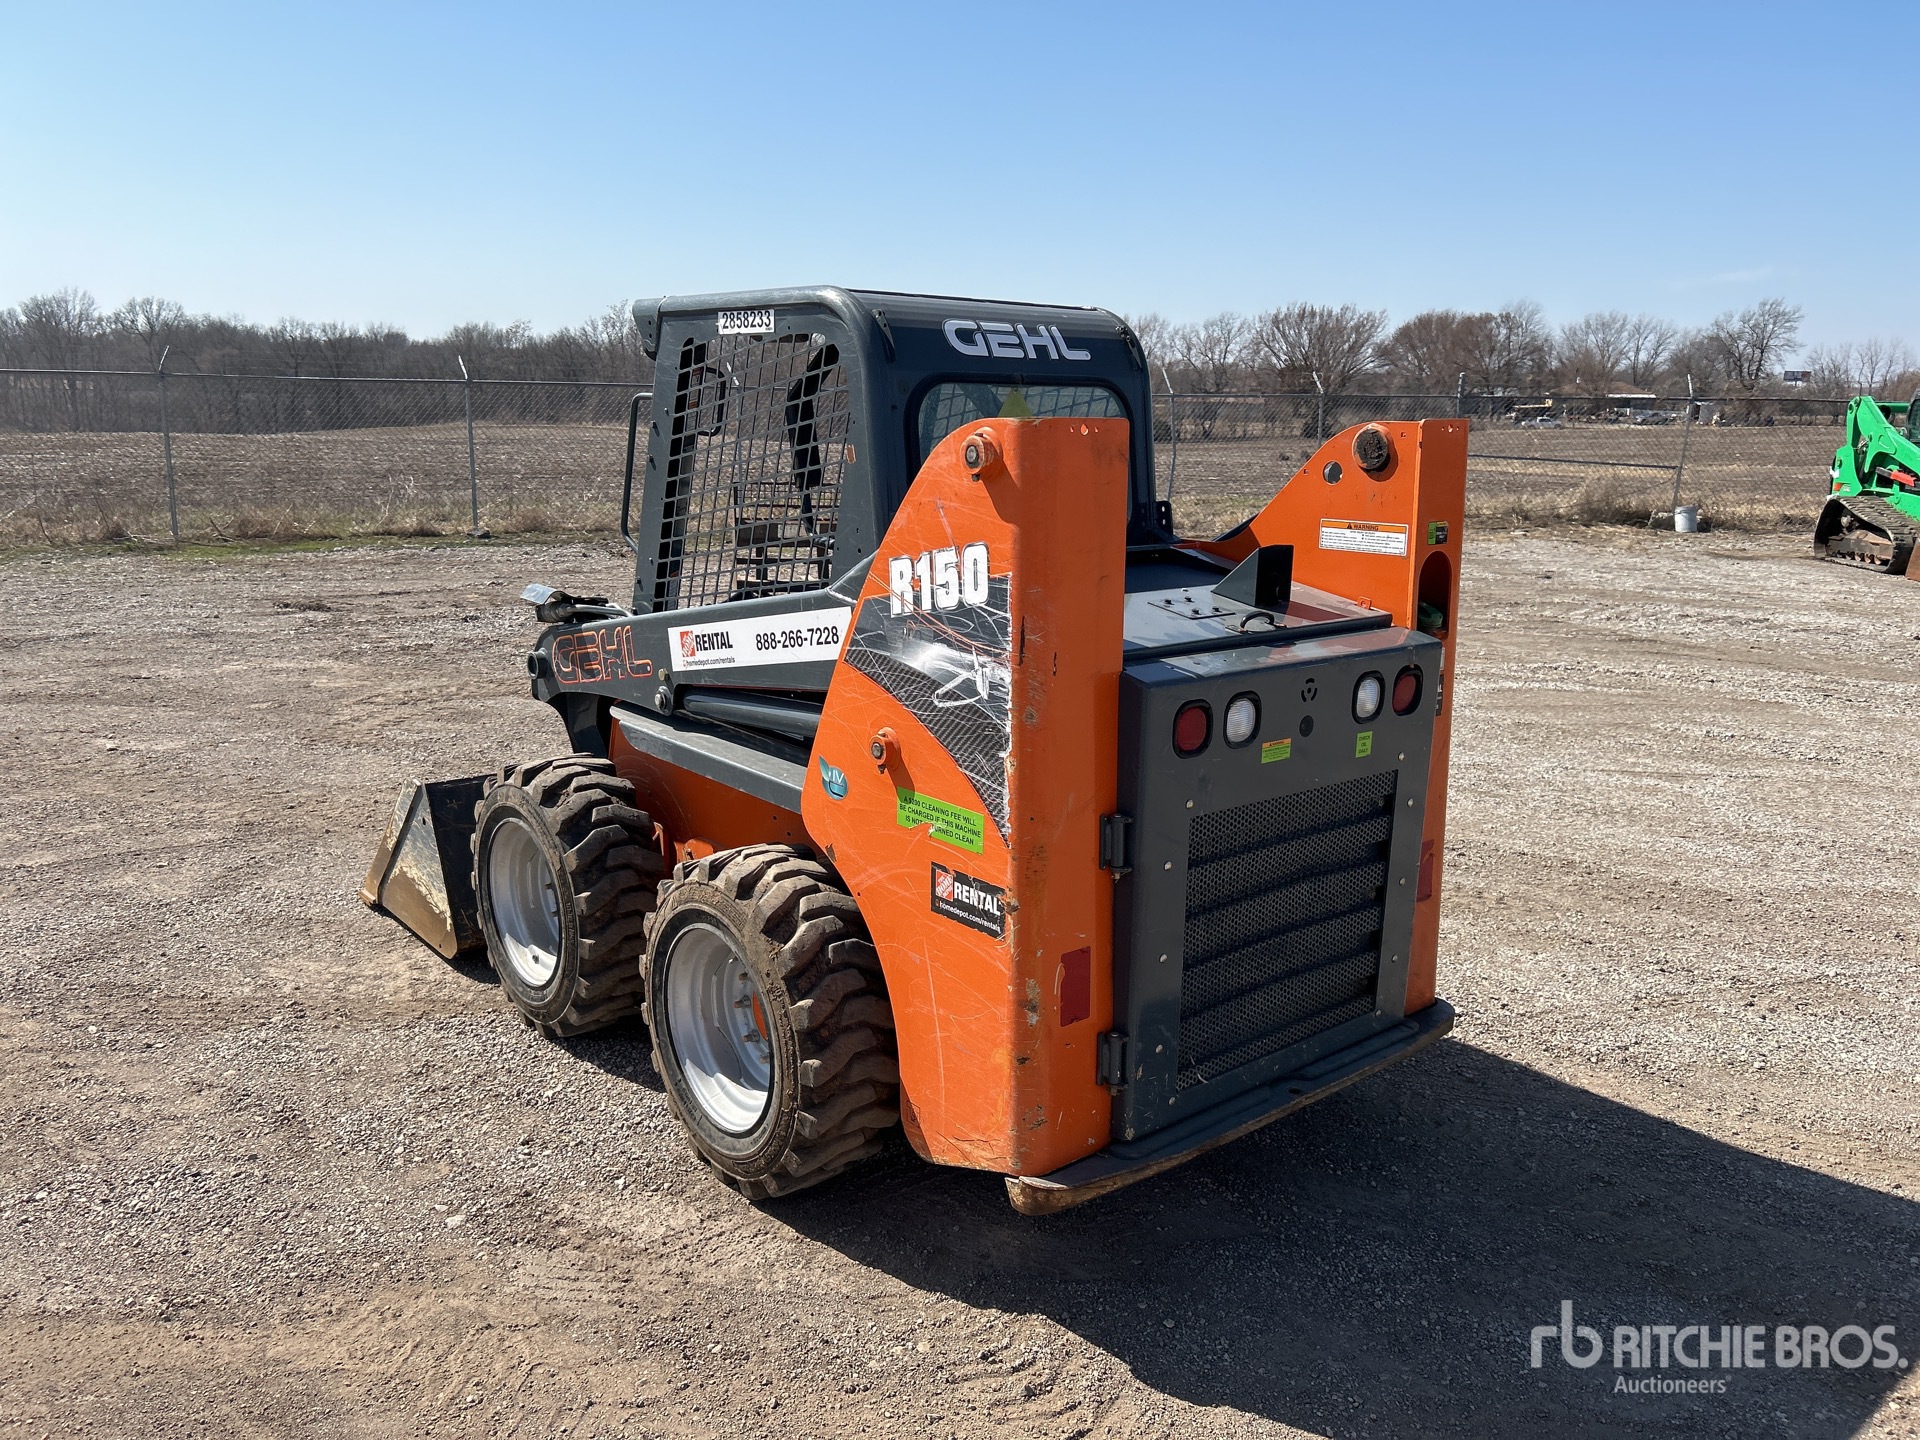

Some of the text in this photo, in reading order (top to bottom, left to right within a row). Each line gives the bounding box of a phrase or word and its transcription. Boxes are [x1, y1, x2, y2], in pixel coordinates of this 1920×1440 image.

[722, 310, 771, 329] 2858233
[942, 318, 1091, 361] GEHL
[1354, 523, 1378, 531] WARNING
[889, 541, 990, 618] R150
[695, 631, 733, 651] RENTAL
[755, 626, 839, 651] 888-266-7228
[552, 625, 653, 684] GEHL
[899, 804, 906, 812] BE
[908, 807, 934, 821] CHARGED
[941, 818, 954, 828] THIS
[955, 823, 981, 838] MACHINE
[921, 802, 949, 816] CLEANING
[951, 812, 961, 821] FEE
[962, 816, 976, 826] WILL
[905, 815, 910, 823] IS
[955, 833, 974, 845] CLEAN
[954, 881, 1001, 916] RENTAL
